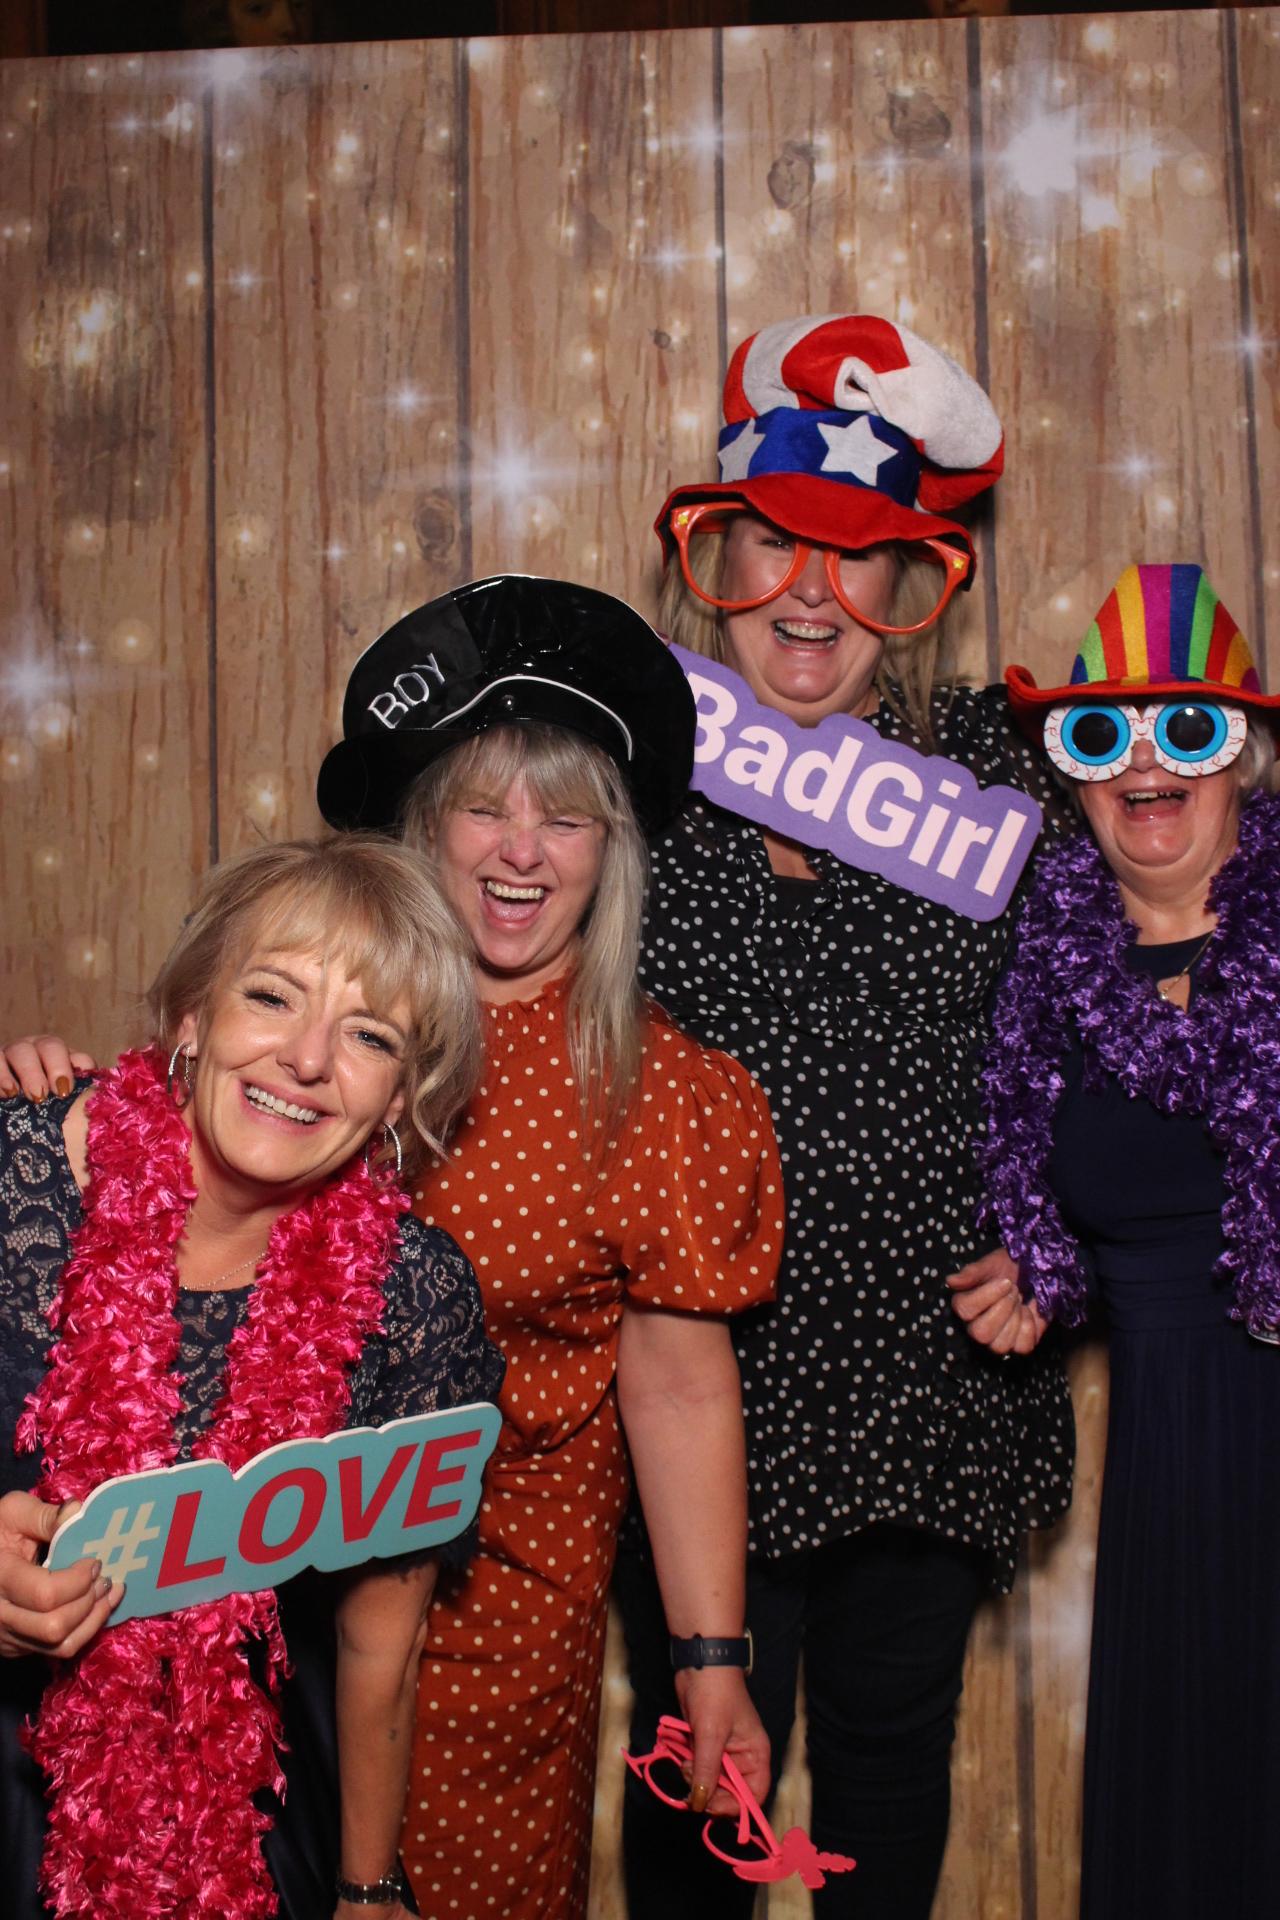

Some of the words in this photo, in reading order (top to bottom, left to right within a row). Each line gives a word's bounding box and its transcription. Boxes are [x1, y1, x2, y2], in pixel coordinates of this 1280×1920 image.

[368, 653, 445, 729] BOY
[688, 671, 1028, 897] BadGirl
[82, 1429, 483, 1590] #LOVE
